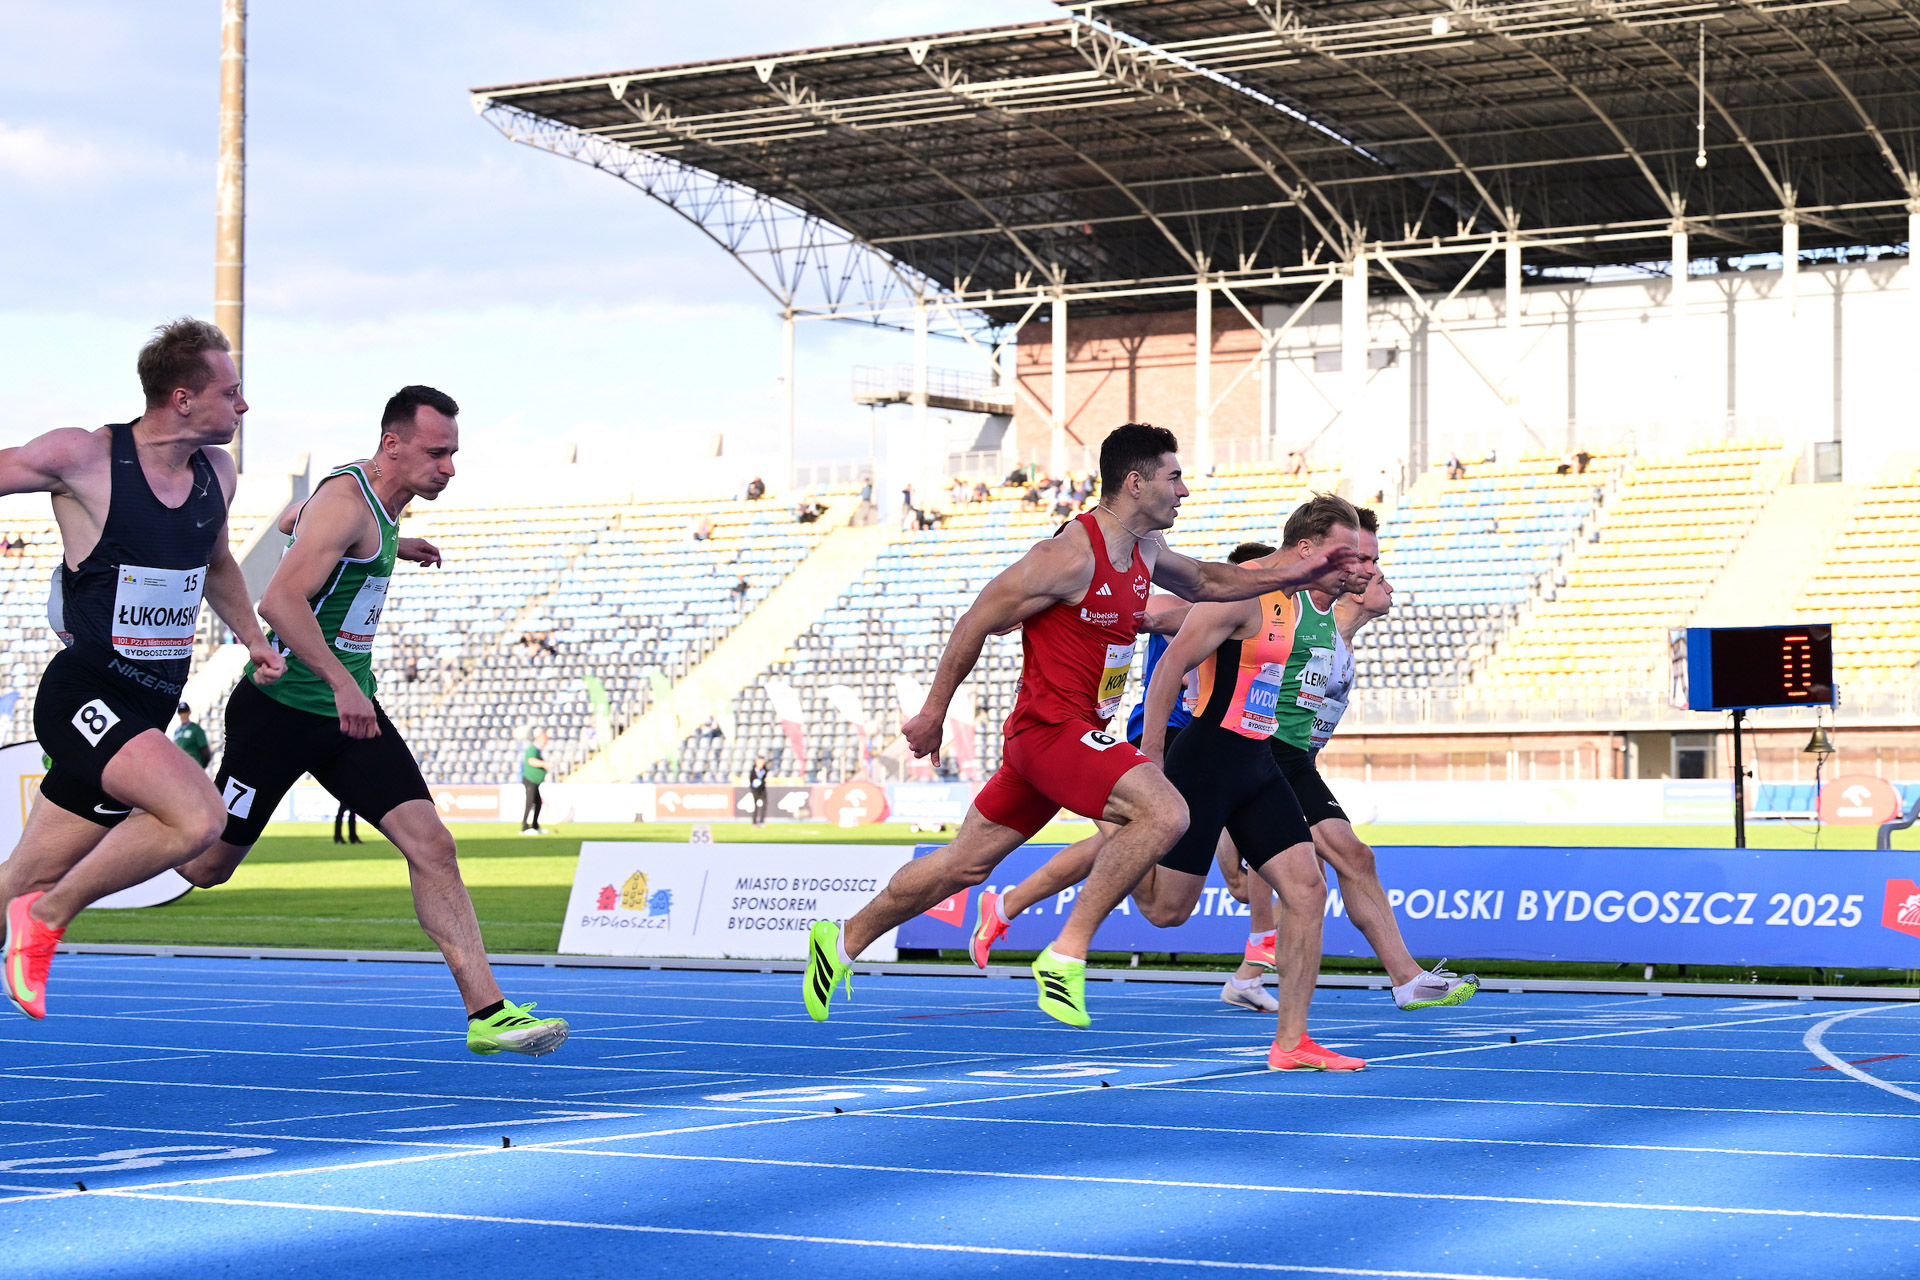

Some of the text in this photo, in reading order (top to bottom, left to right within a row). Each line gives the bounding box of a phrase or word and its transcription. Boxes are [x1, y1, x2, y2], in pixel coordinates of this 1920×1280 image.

[183, 574, 198, 592] 15
[130, 638, 148, 646] PZLA
[125, 648, 172, 657] BYDGOSZCZ
[108, 658, 181, 695] NIKE PRO
[81, 706, 107, 735] 8
[1090, 731, 1116, 745] 6
[228, 782, 248, 810] 7
[692, 830, 710, 844] 55
[735, 877, 877, 892] MIASTO BYDGOSZCZ
[731, 897, 817, 911] SPONSOREM
[1387, 888, 1505, 919] POLSKI
[1516, 889, 1758, 925] BYDGOSZCZ
[1765, 892, 1864, 928] 2025
[581, 915, 667, 928] BYDGOSZCZ
